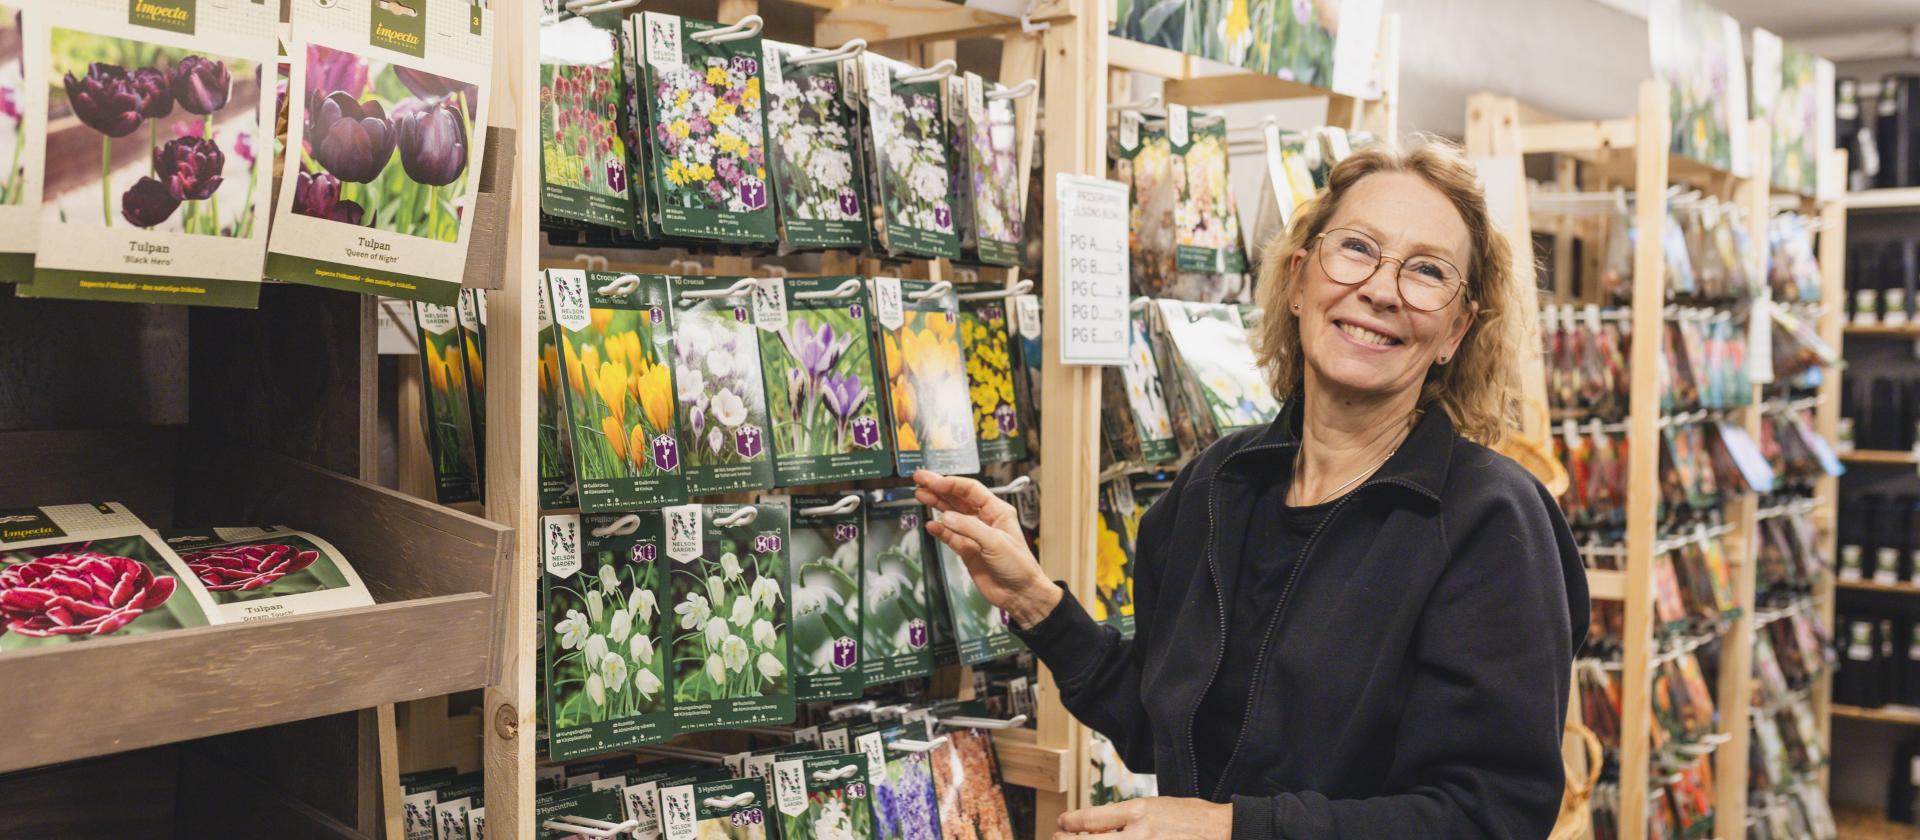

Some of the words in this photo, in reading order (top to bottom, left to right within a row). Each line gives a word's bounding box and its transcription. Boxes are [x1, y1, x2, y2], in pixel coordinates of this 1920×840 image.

[473, 17, 479, 26] 3
[129, 241, 170, 255] Tulpan
[358, 237, 391, 251] Tulpan
[1071, 234, 1087, 250] PG
[345, 248, 369, 258] 'Queen
[379, 254, 399, 264] Night'
[1071, 258, 1087, 273] PG
[1071, 281, 1087, 297] PG
[1072, 304, 1088, 320] PG
[1072, 327, 1088, 343] PG
[245, 603, 284, 614] Tulpan
[703, 784, 734, 794] Hyacinthus
[541, 800, 579, 814] Hyacinthus
[671, 823, 693, 832] NELSON
[672, 830, 694, 838] GARDEN
